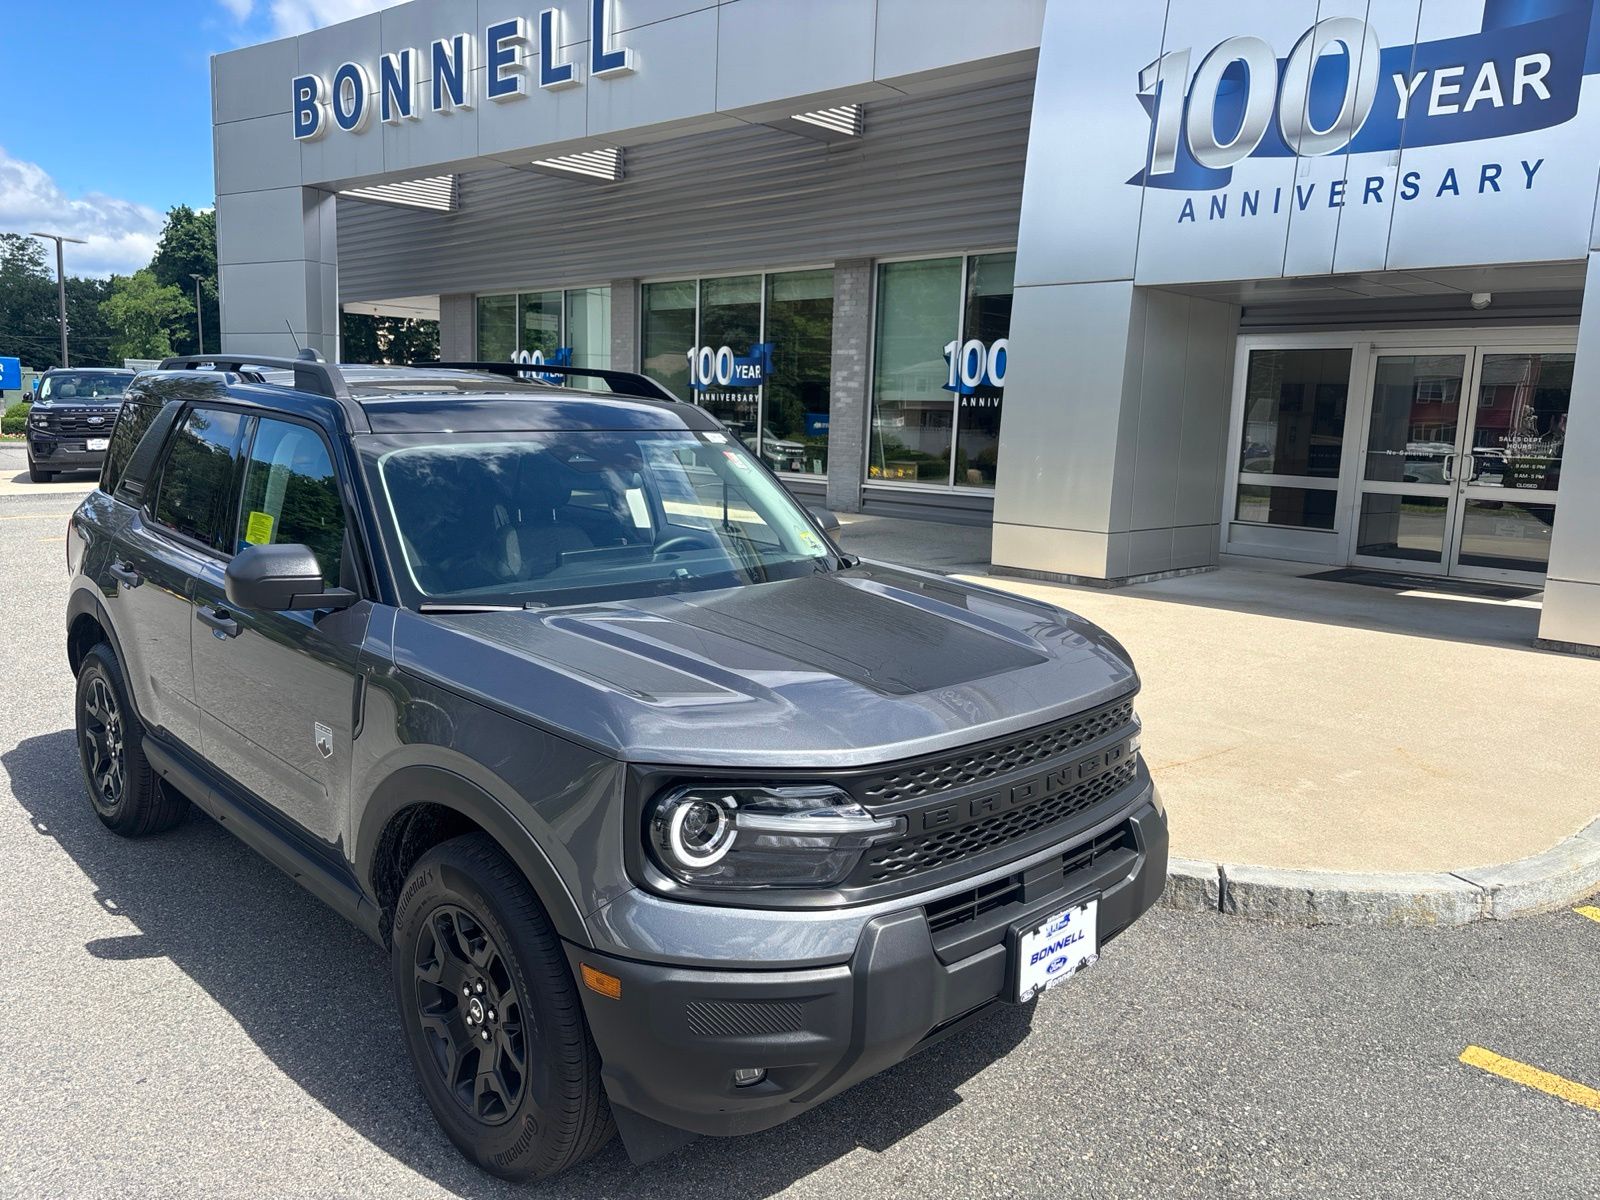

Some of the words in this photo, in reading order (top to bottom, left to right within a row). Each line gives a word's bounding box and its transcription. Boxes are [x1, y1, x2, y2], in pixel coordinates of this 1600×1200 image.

[292, 0, 633, 140] BONNELL
[1137, 15, 1381, 176] 100
[1391, 52, 1552, 120] YEAR
[1177, 158, 1545, 224] ANNIVERSARY
[687, 345, 735, 386] 100
[735, 364, 762, 379] YEAR
[943, 337, 1009, 388] 100
[699, 392, 759, 403] ANNIVERSARY
[961, 397, 1000, 408] ANNIV
[922, 743, 1125, 831] BRONCO
[395, 870, 428, 931] Continental
[1029, 929, 1085, 967] BONNELL
